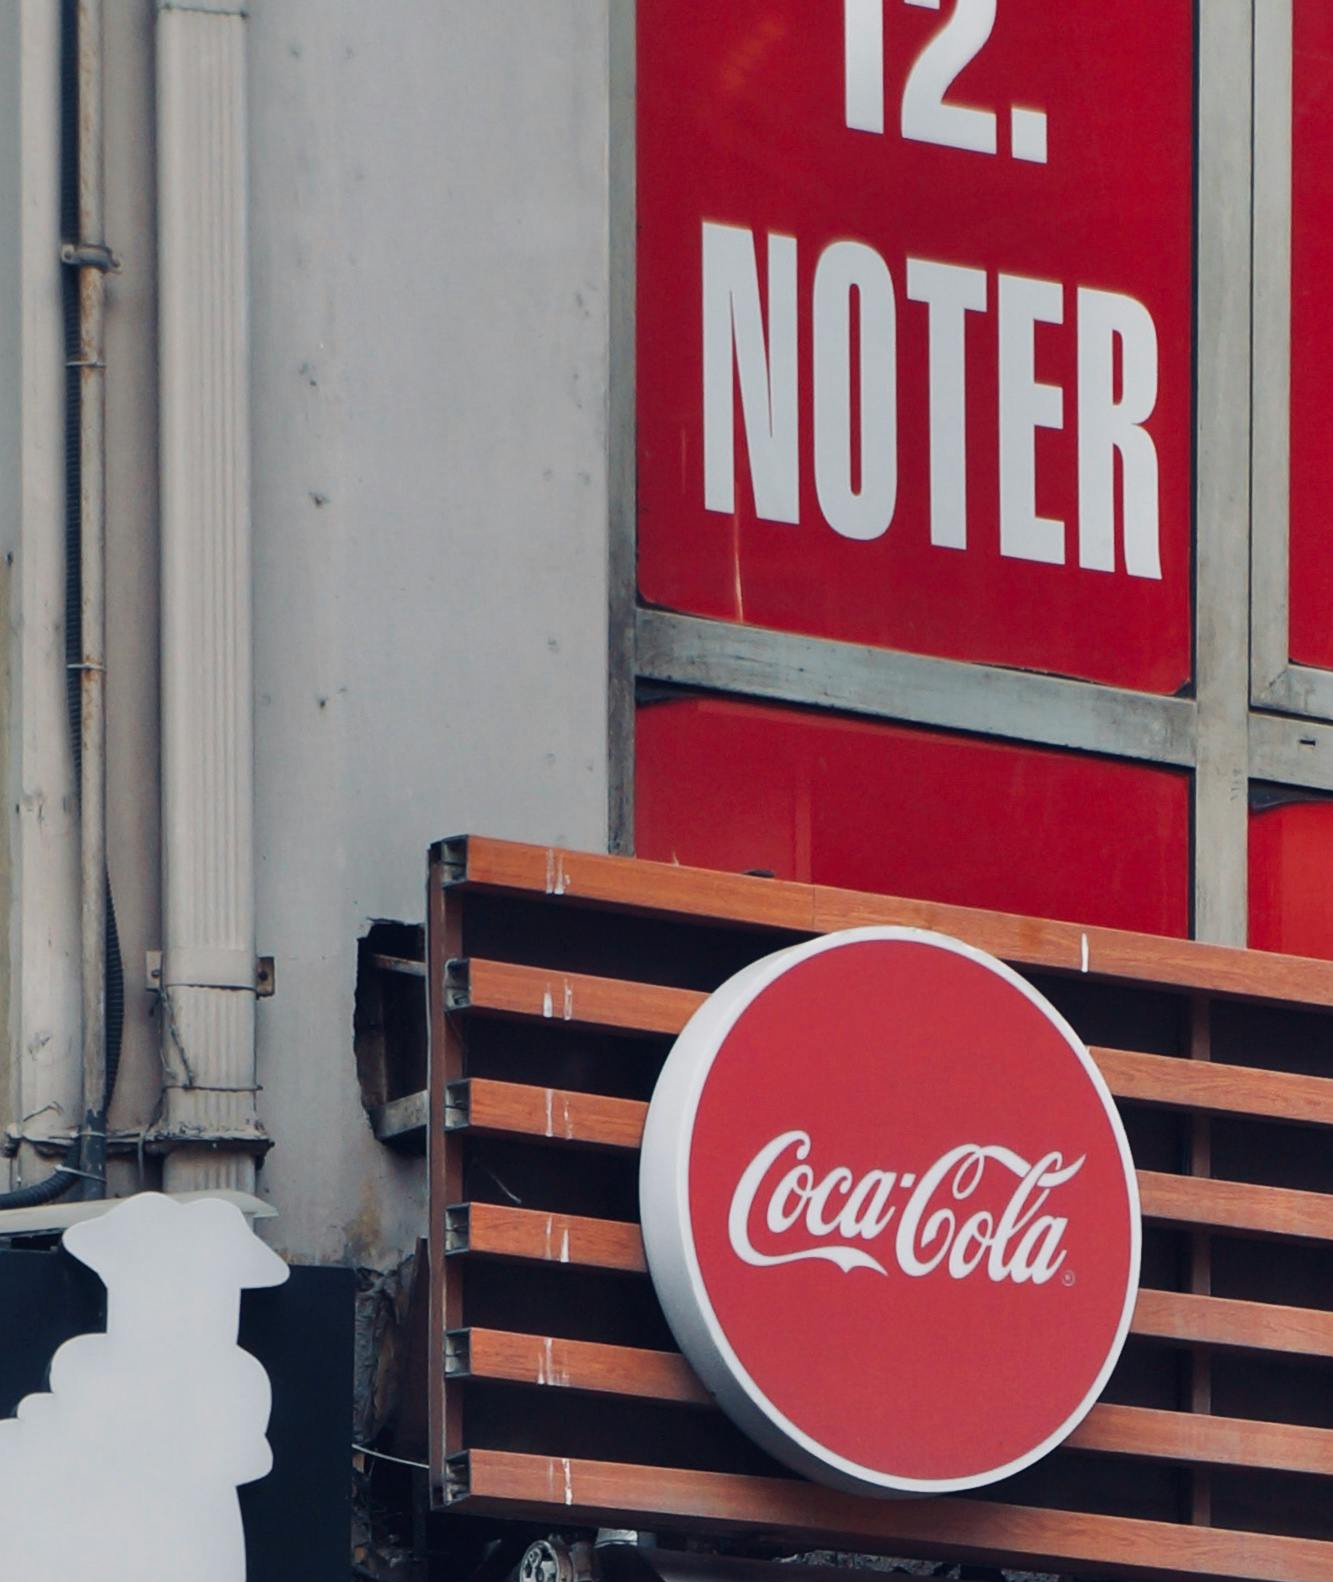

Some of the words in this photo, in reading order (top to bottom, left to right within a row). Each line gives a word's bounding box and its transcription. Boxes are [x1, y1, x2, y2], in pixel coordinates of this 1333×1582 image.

[845, 0, 1047, 163] 12.
[702, 220, 1163, 580] NOTER
[728, 1130, 1086, 1286] Coca-Cola
